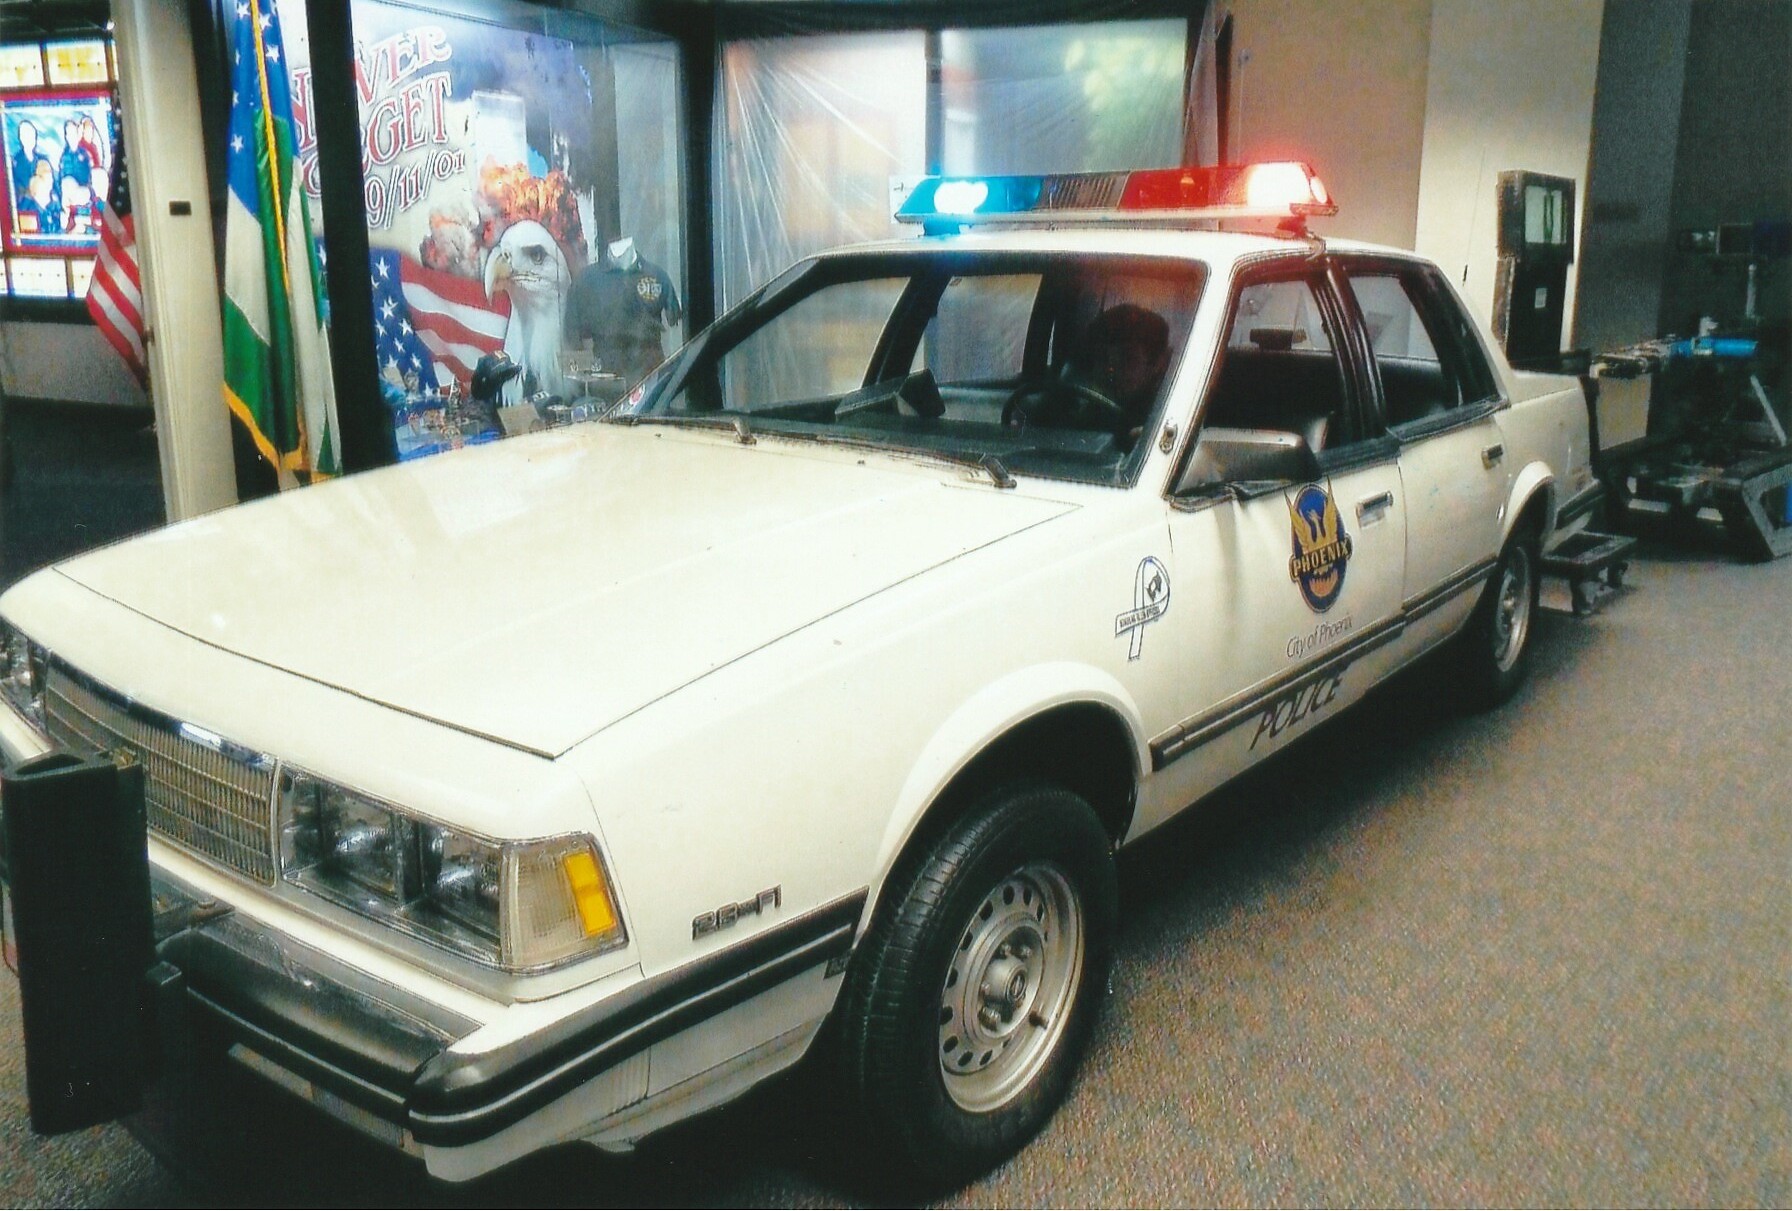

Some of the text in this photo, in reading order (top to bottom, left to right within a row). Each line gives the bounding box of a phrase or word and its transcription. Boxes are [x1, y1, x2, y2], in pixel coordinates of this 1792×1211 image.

[365, 150, 466, 230] 9/11/01
[1292, 539, 1349, 577] PHOENIX
[1286, 612, 1353, 658] City of Phoenix
[1249, 676, 1343, 751] POLICE
